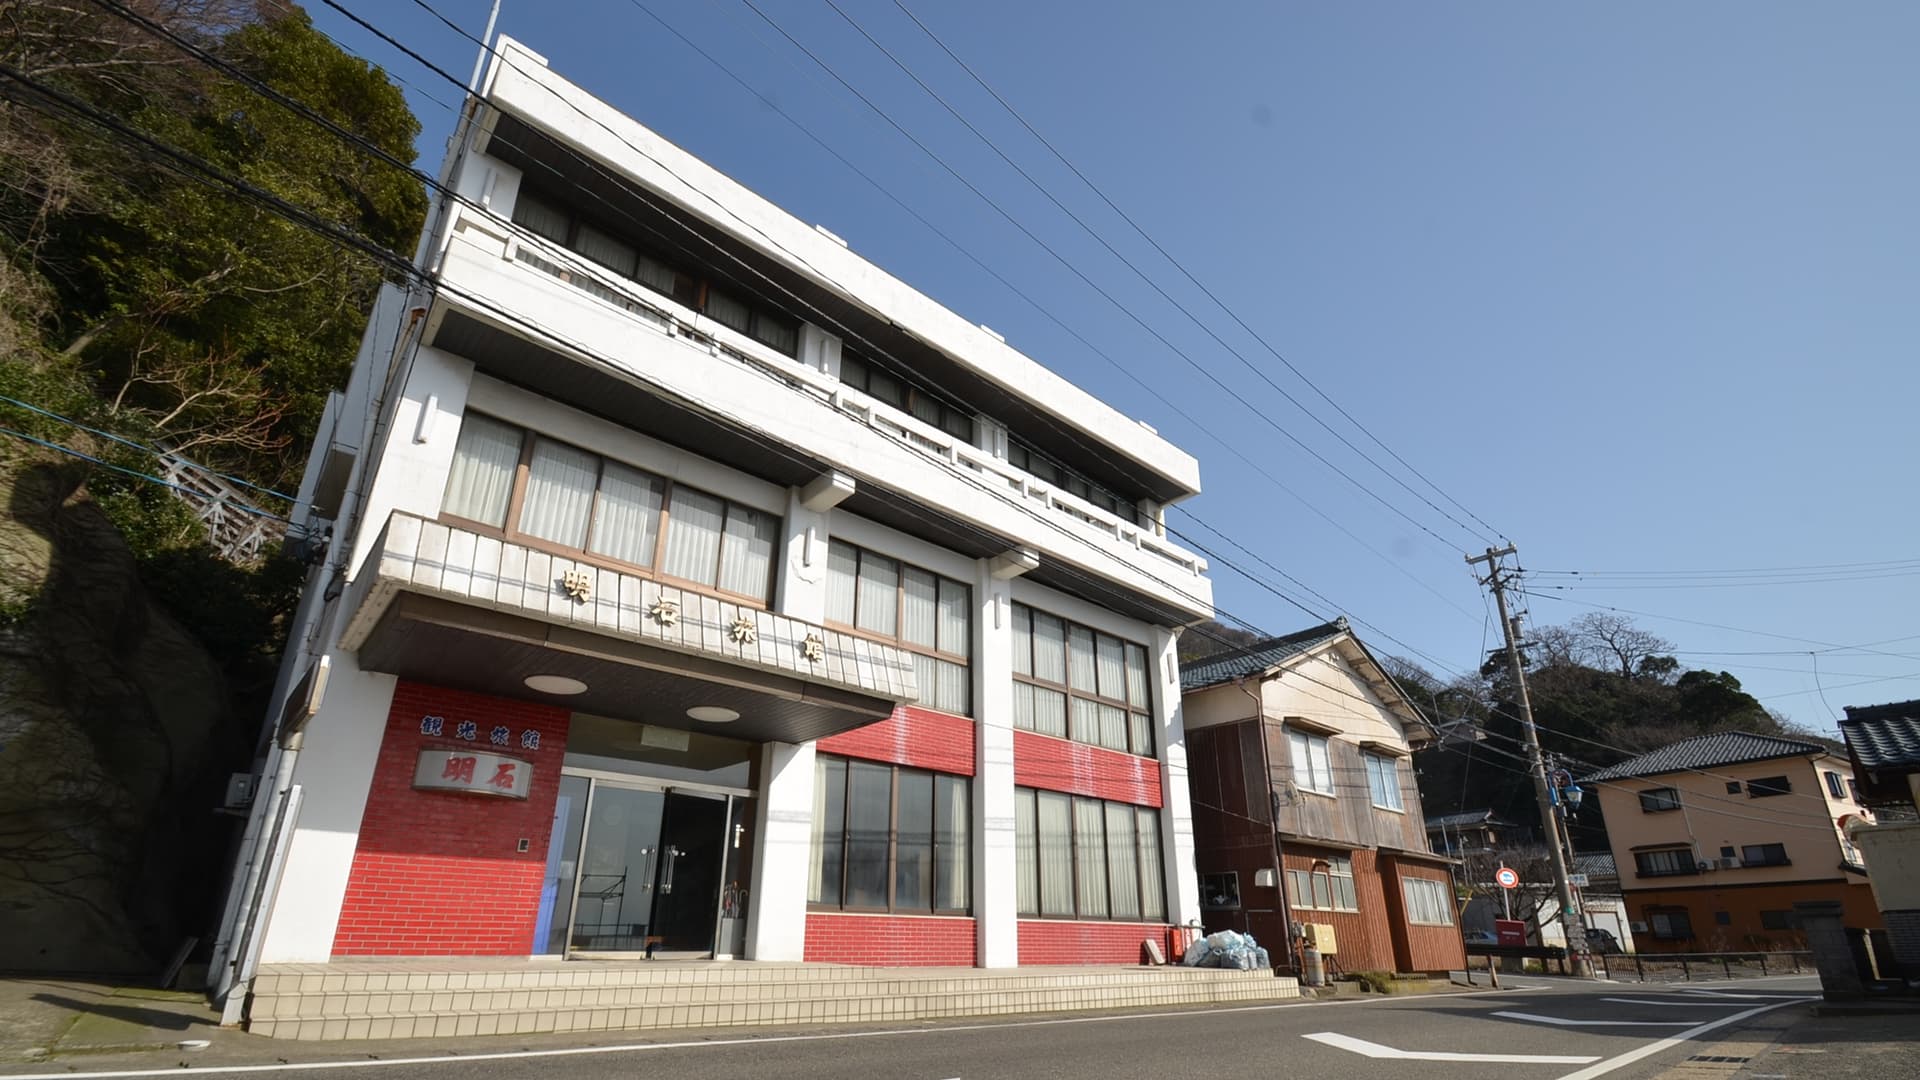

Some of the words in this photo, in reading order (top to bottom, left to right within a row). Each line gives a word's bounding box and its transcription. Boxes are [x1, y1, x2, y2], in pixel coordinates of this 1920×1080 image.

[564, 569, 825, 663] 明石旅館
[420, 715, 541, 750] 観光旅館
[442, 756, 516, 789] 明石
